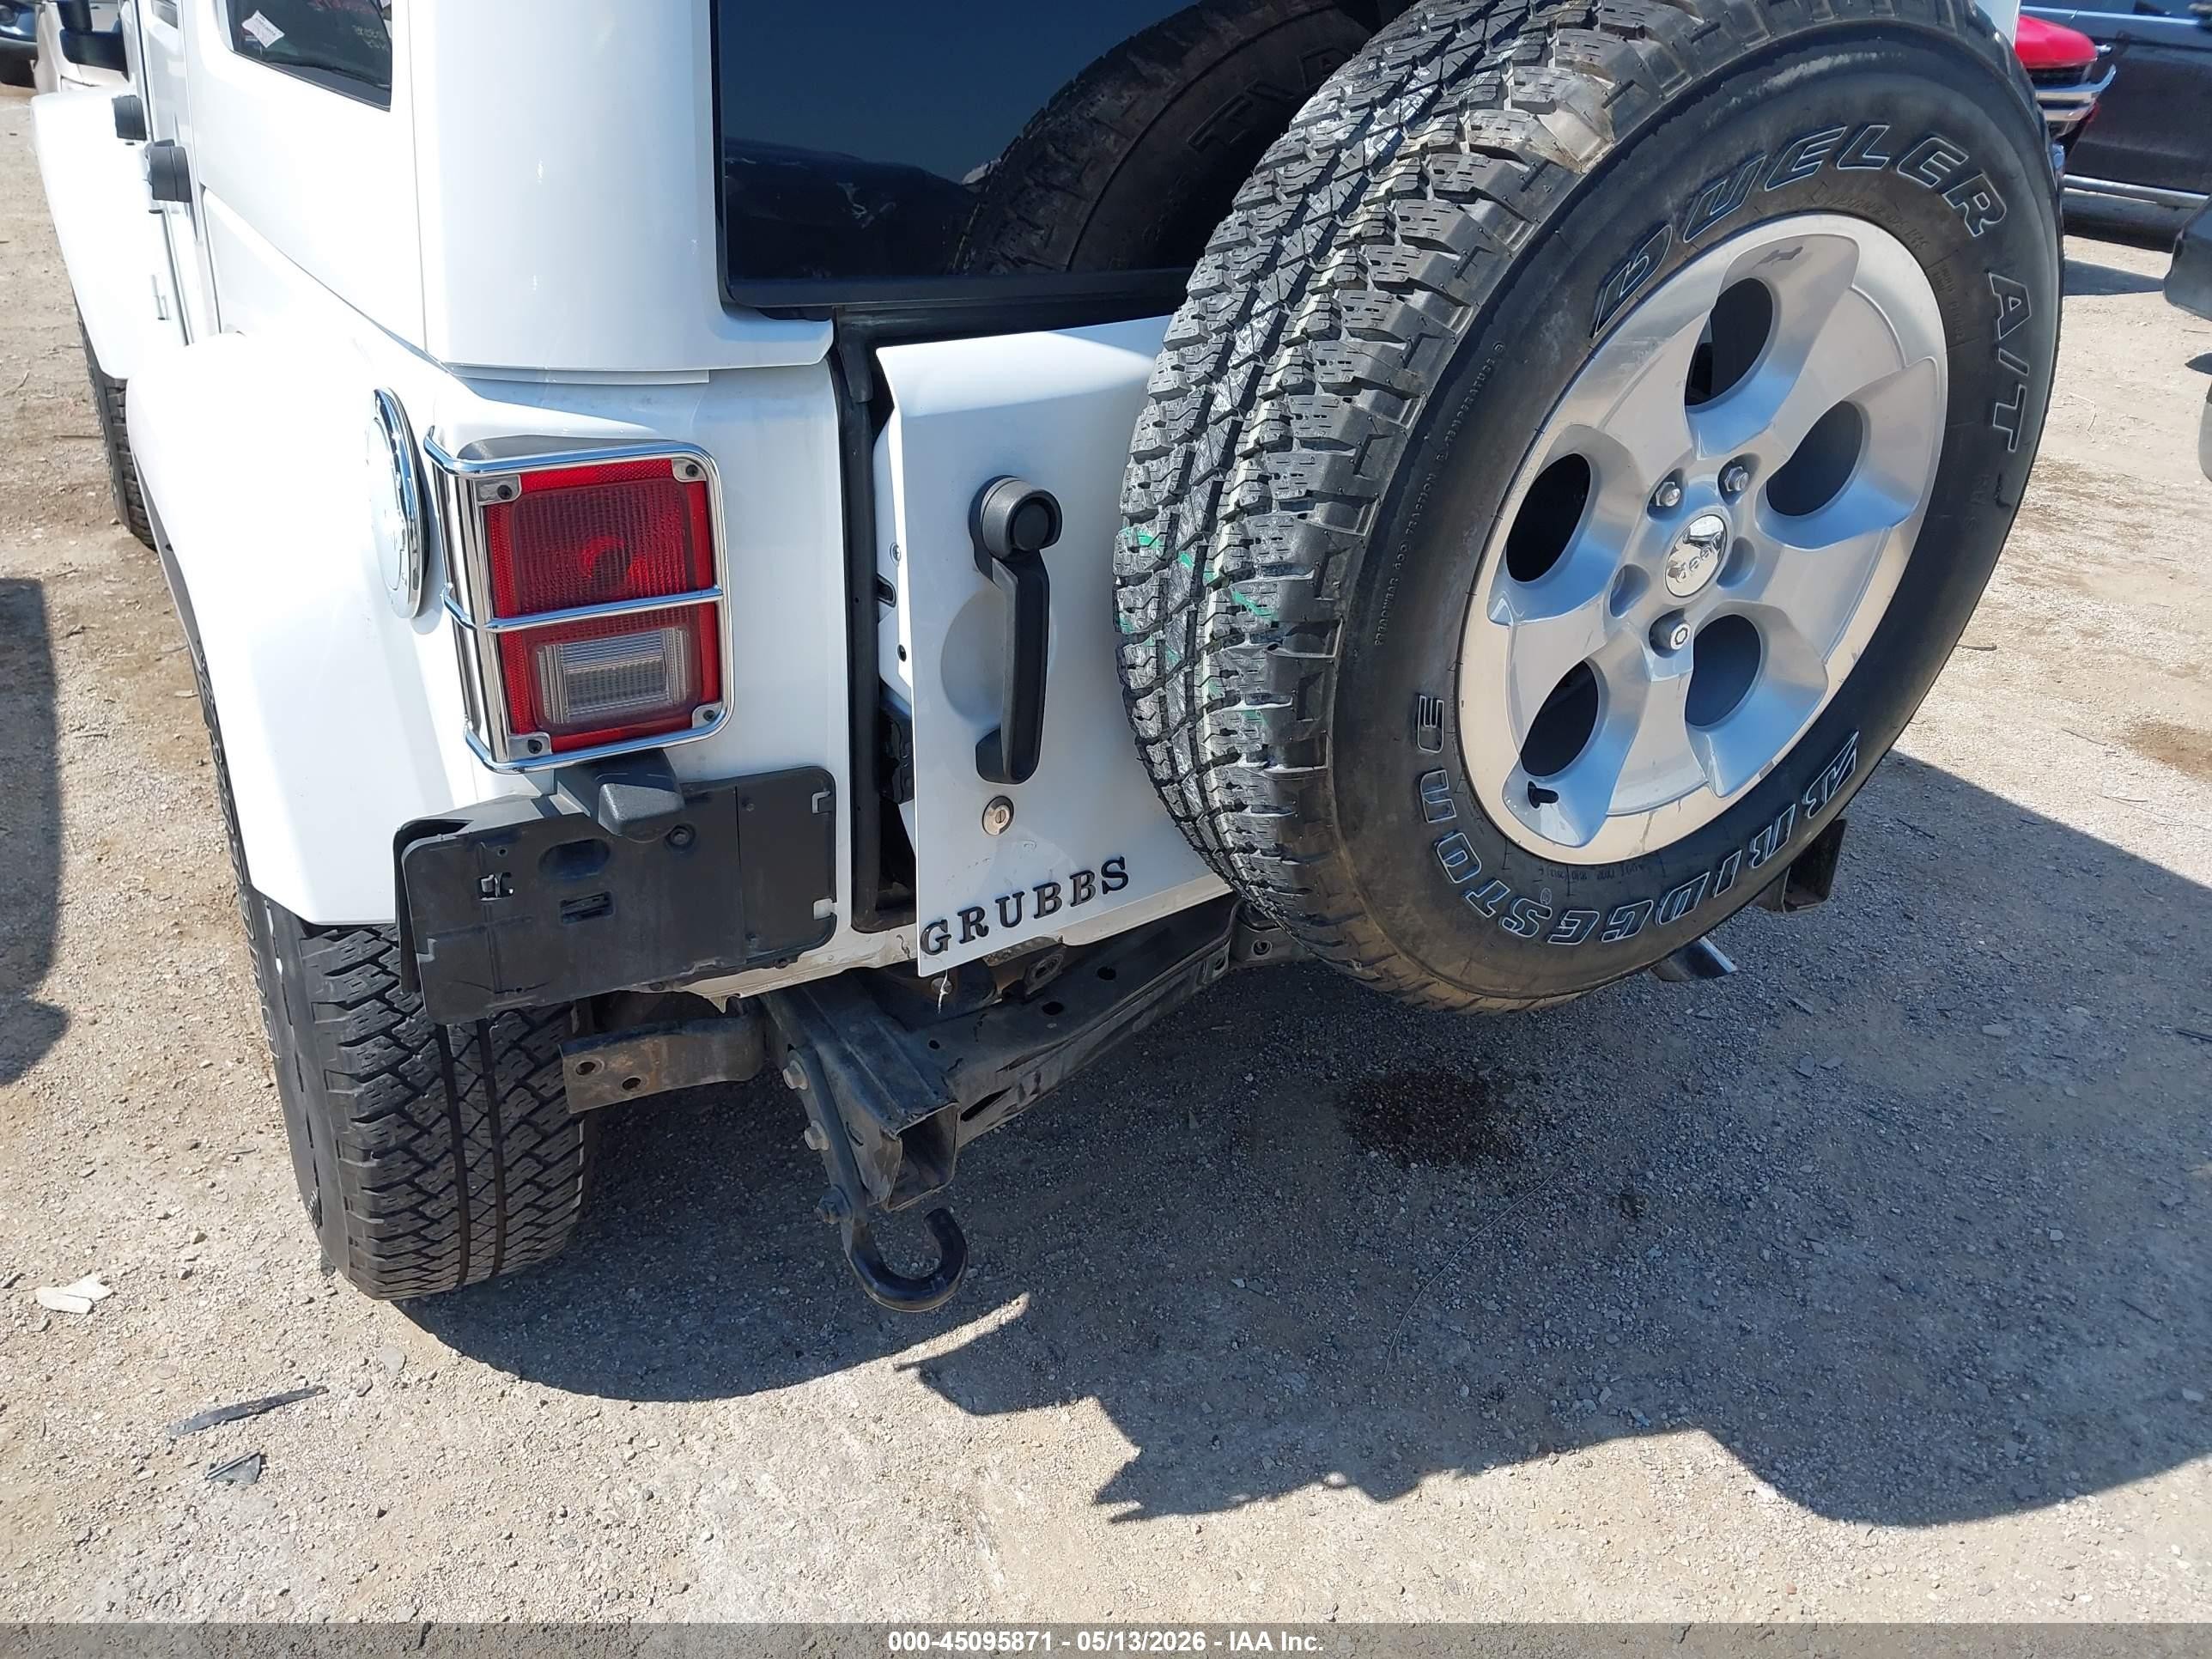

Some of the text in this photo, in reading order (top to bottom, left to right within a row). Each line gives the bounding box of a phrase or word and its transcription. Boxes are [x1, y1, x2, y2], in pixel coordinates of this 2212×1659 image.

[1590, 124, 2031, 453] DUELER A/T
[919, 855, 1129, 956] GRUBBS
[1417, 694, 1860, 945] BRIDGESTONE
